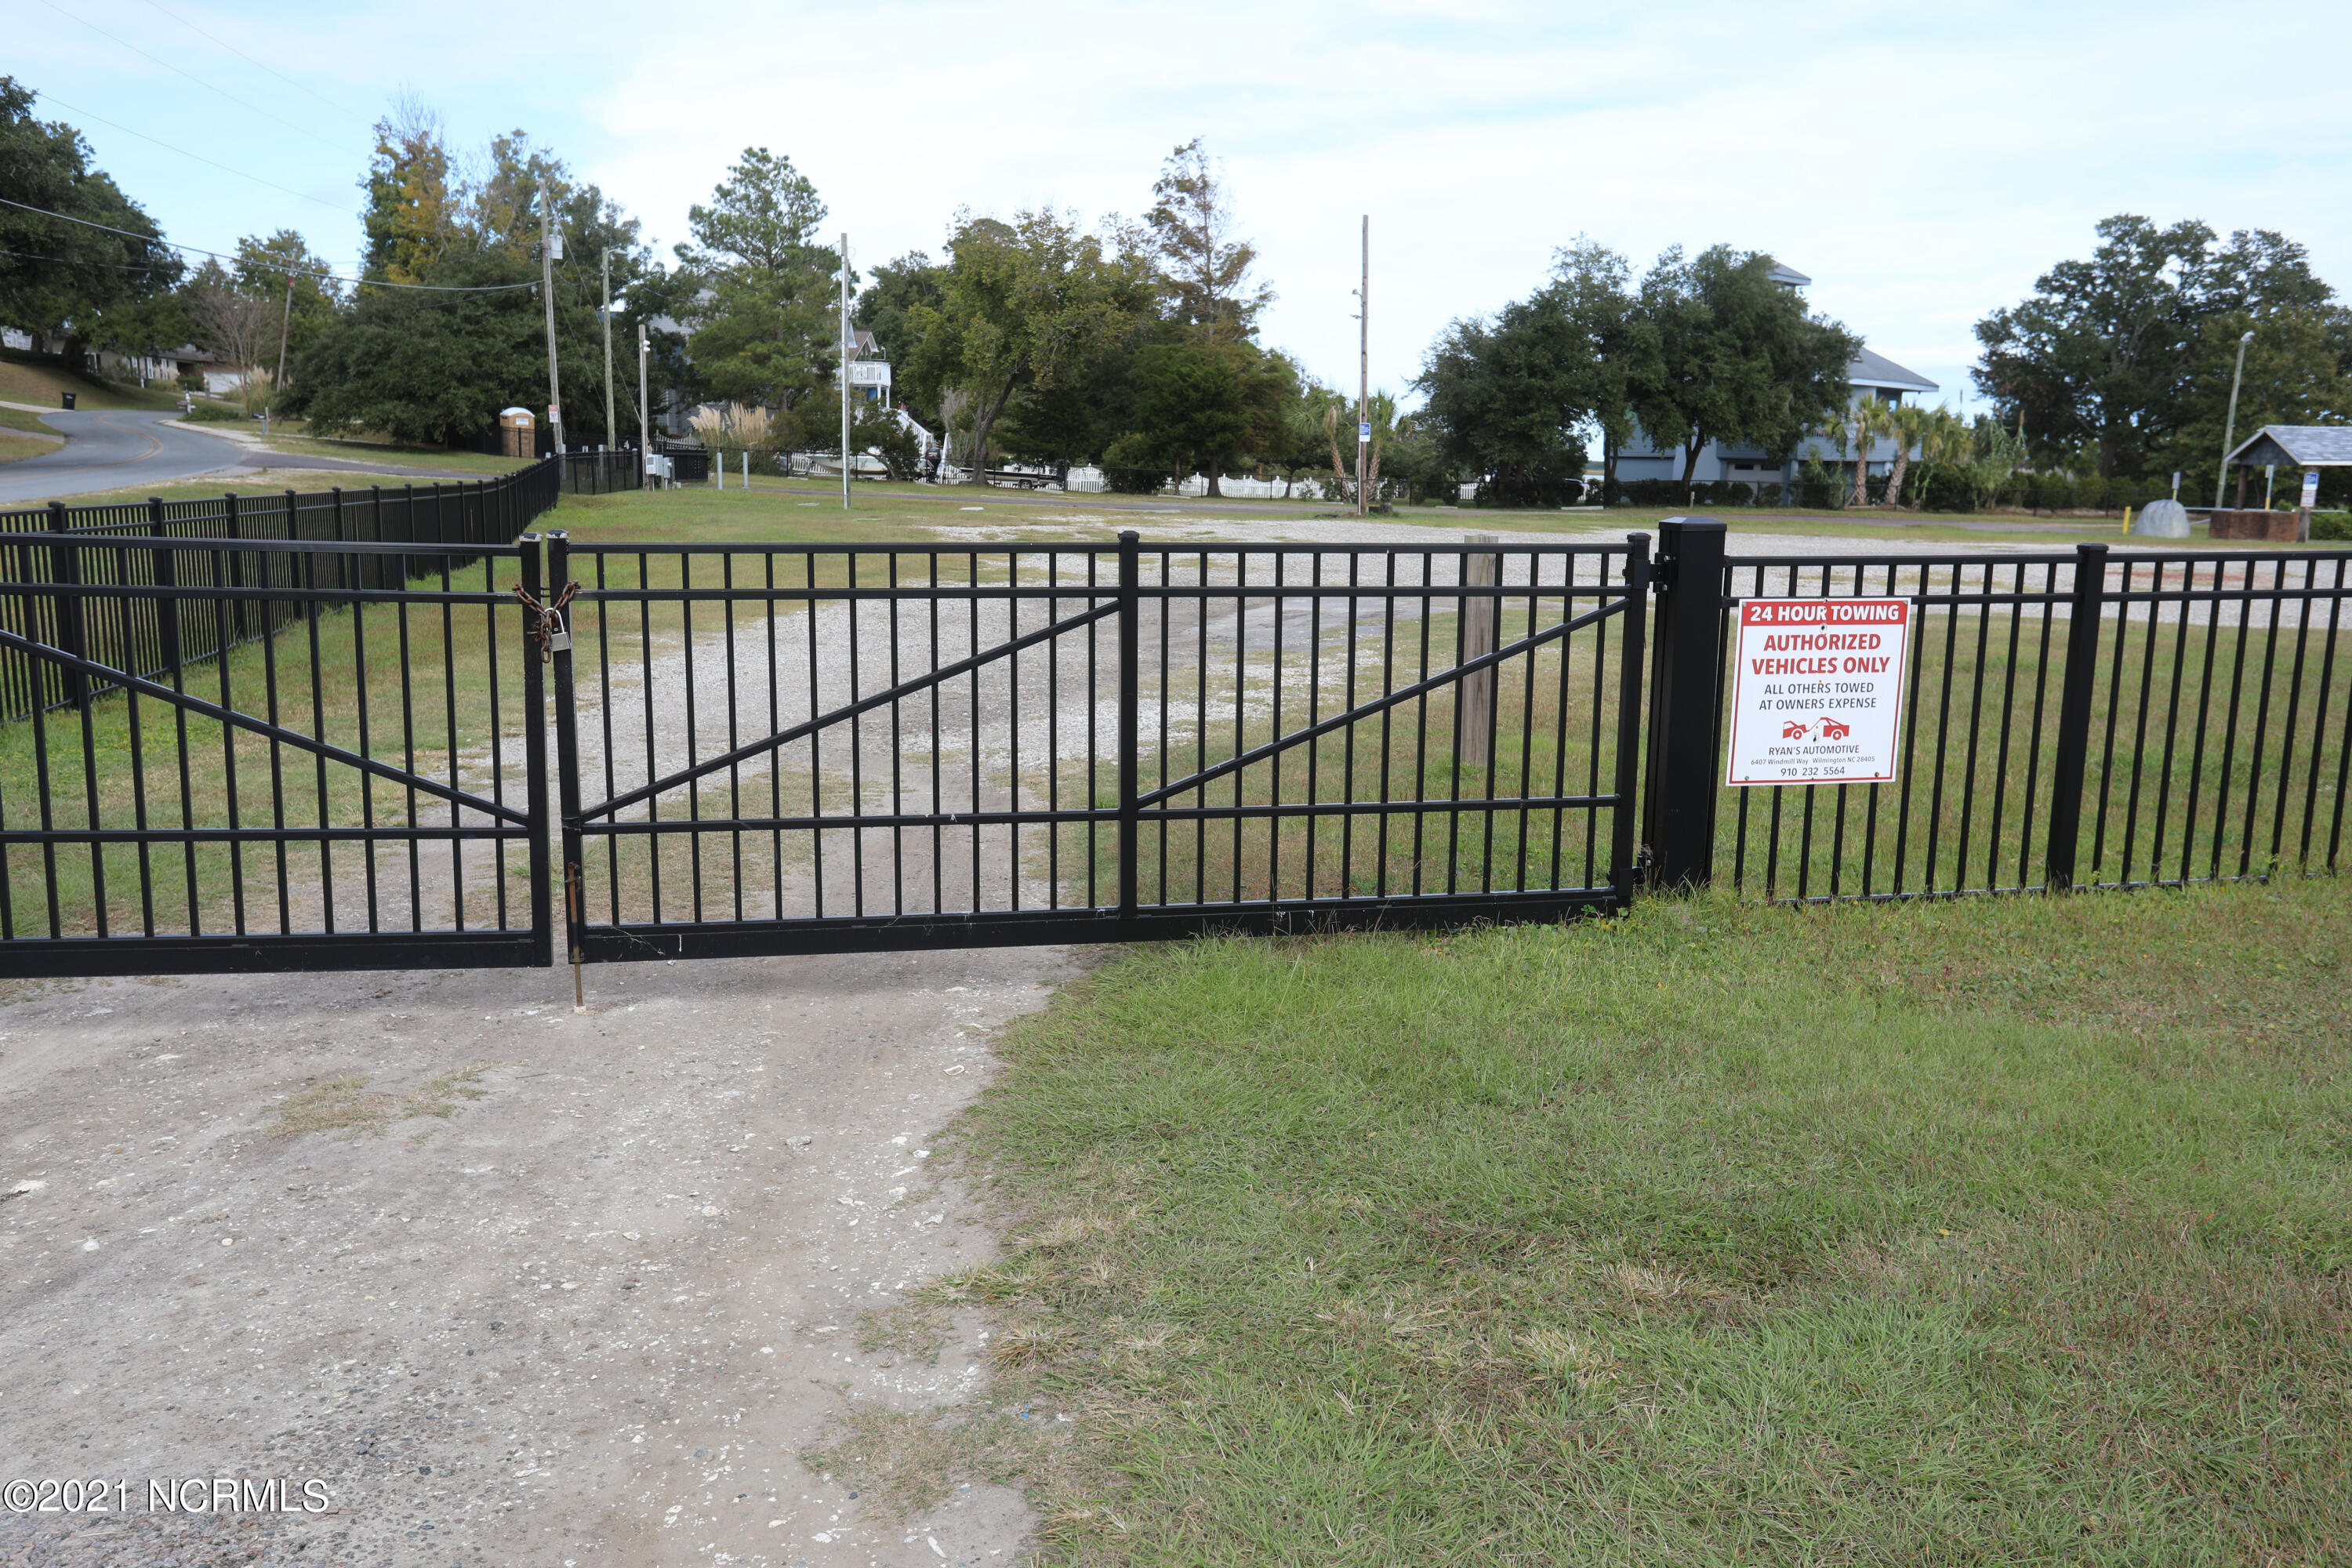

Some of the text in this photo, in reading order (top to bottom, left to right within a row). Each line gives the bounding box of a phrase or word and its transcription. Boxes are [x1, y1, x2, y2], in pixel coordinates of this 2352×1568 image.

[1750, 604, 1899, 621] 24 HOUR TOWING
[1763, 633, 1881, 651] AUTHORIZED
[1751, 657, 1890, 674] VEHICLES ONLY
[1764, 682, 1875, 695] ALL OTHERS TOWED
[1759, 698, 1877, 710] AT OWNERS EXPENSE
[1769, 745, 1860, 756] RYAN'S AUTOMOTIVE
[1780, 766, 1846, 776] 910 232 5564
